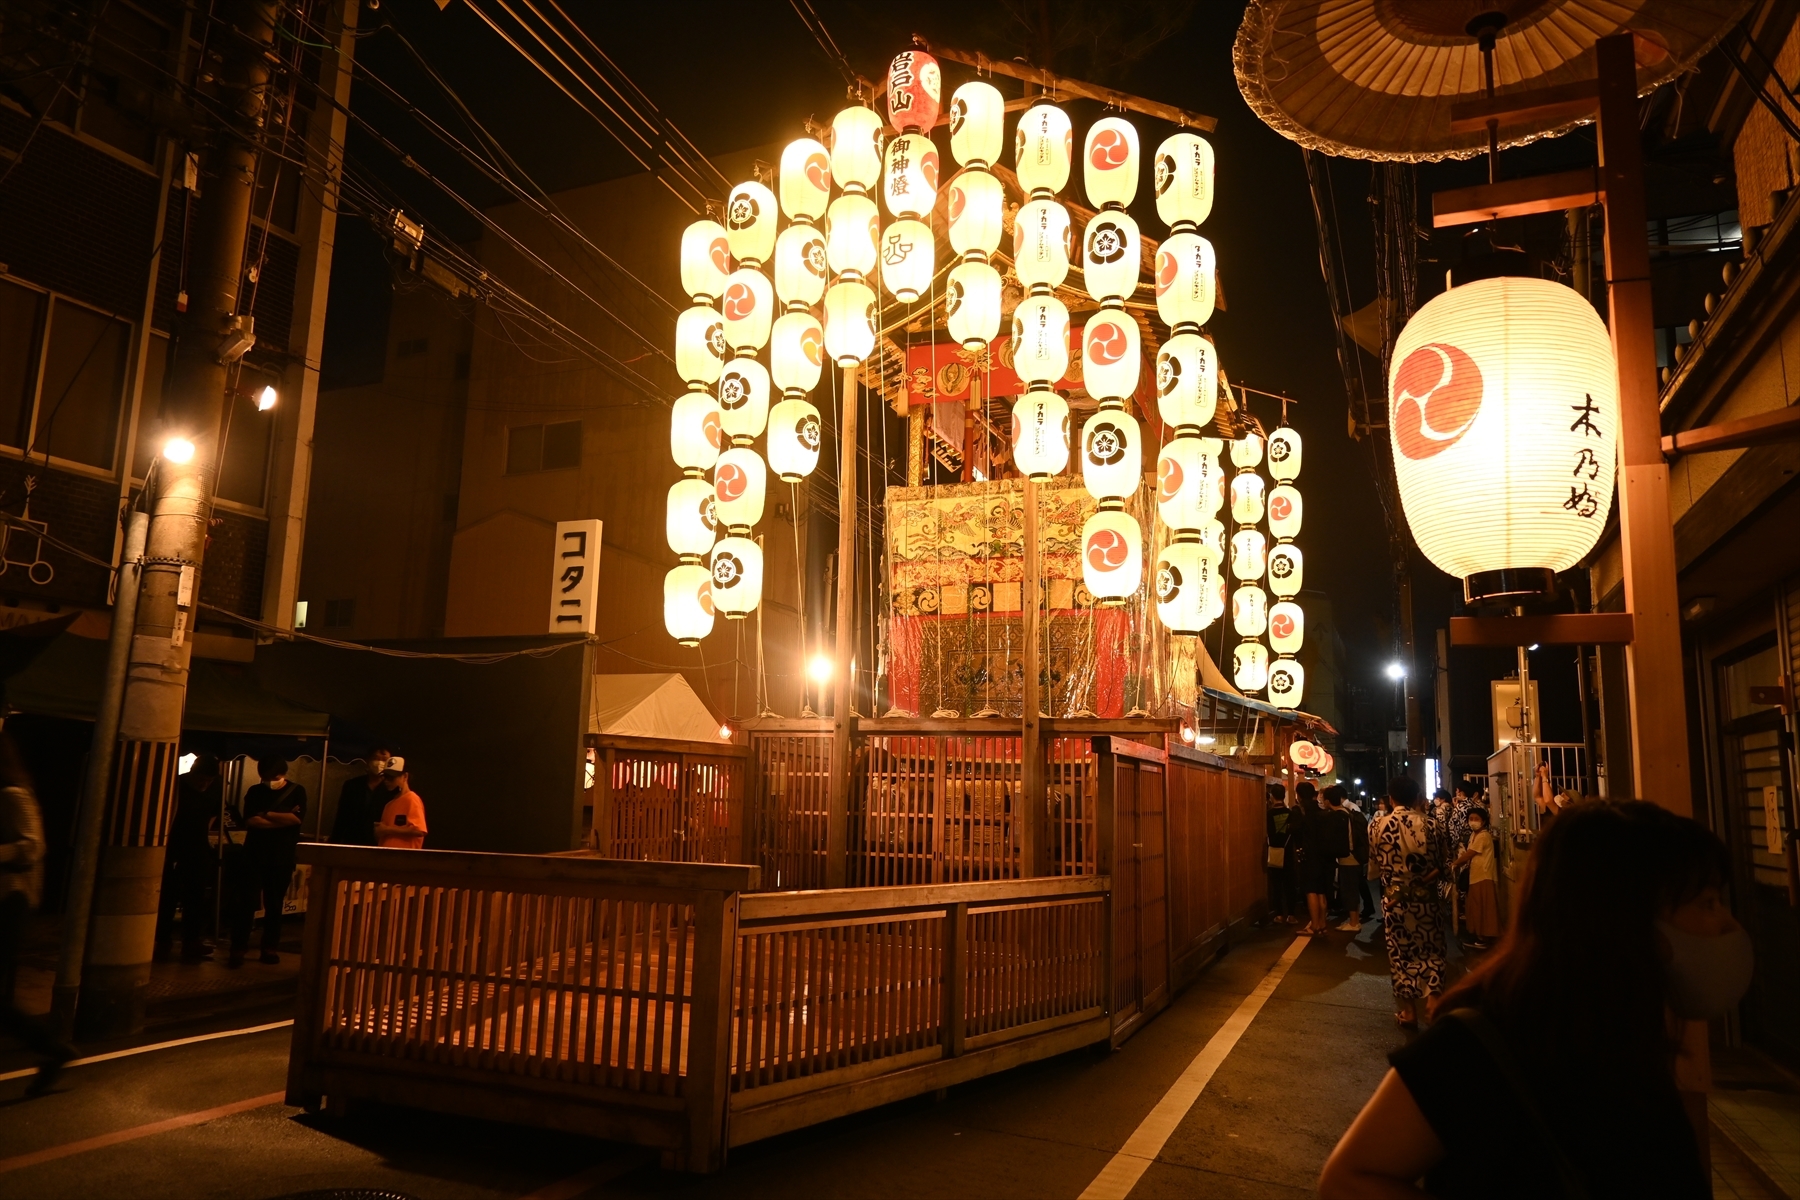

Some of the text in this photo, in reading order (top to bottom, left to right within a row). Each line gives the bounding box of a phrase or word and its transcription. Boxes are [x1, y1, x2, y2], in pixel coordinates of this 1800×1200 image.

[892, 51, 912, 113] 岩戸山
[1193, 143, 1201, 166] タカラ
[891, 138, 911, 196] 御神燈
[1194, 245, 1202, 269] タカラ
[1198, 349, 1206, 373] タカラ
[1036, 403, 1044, 426] タカラ
[556, 531, 587, 623] コタニ
